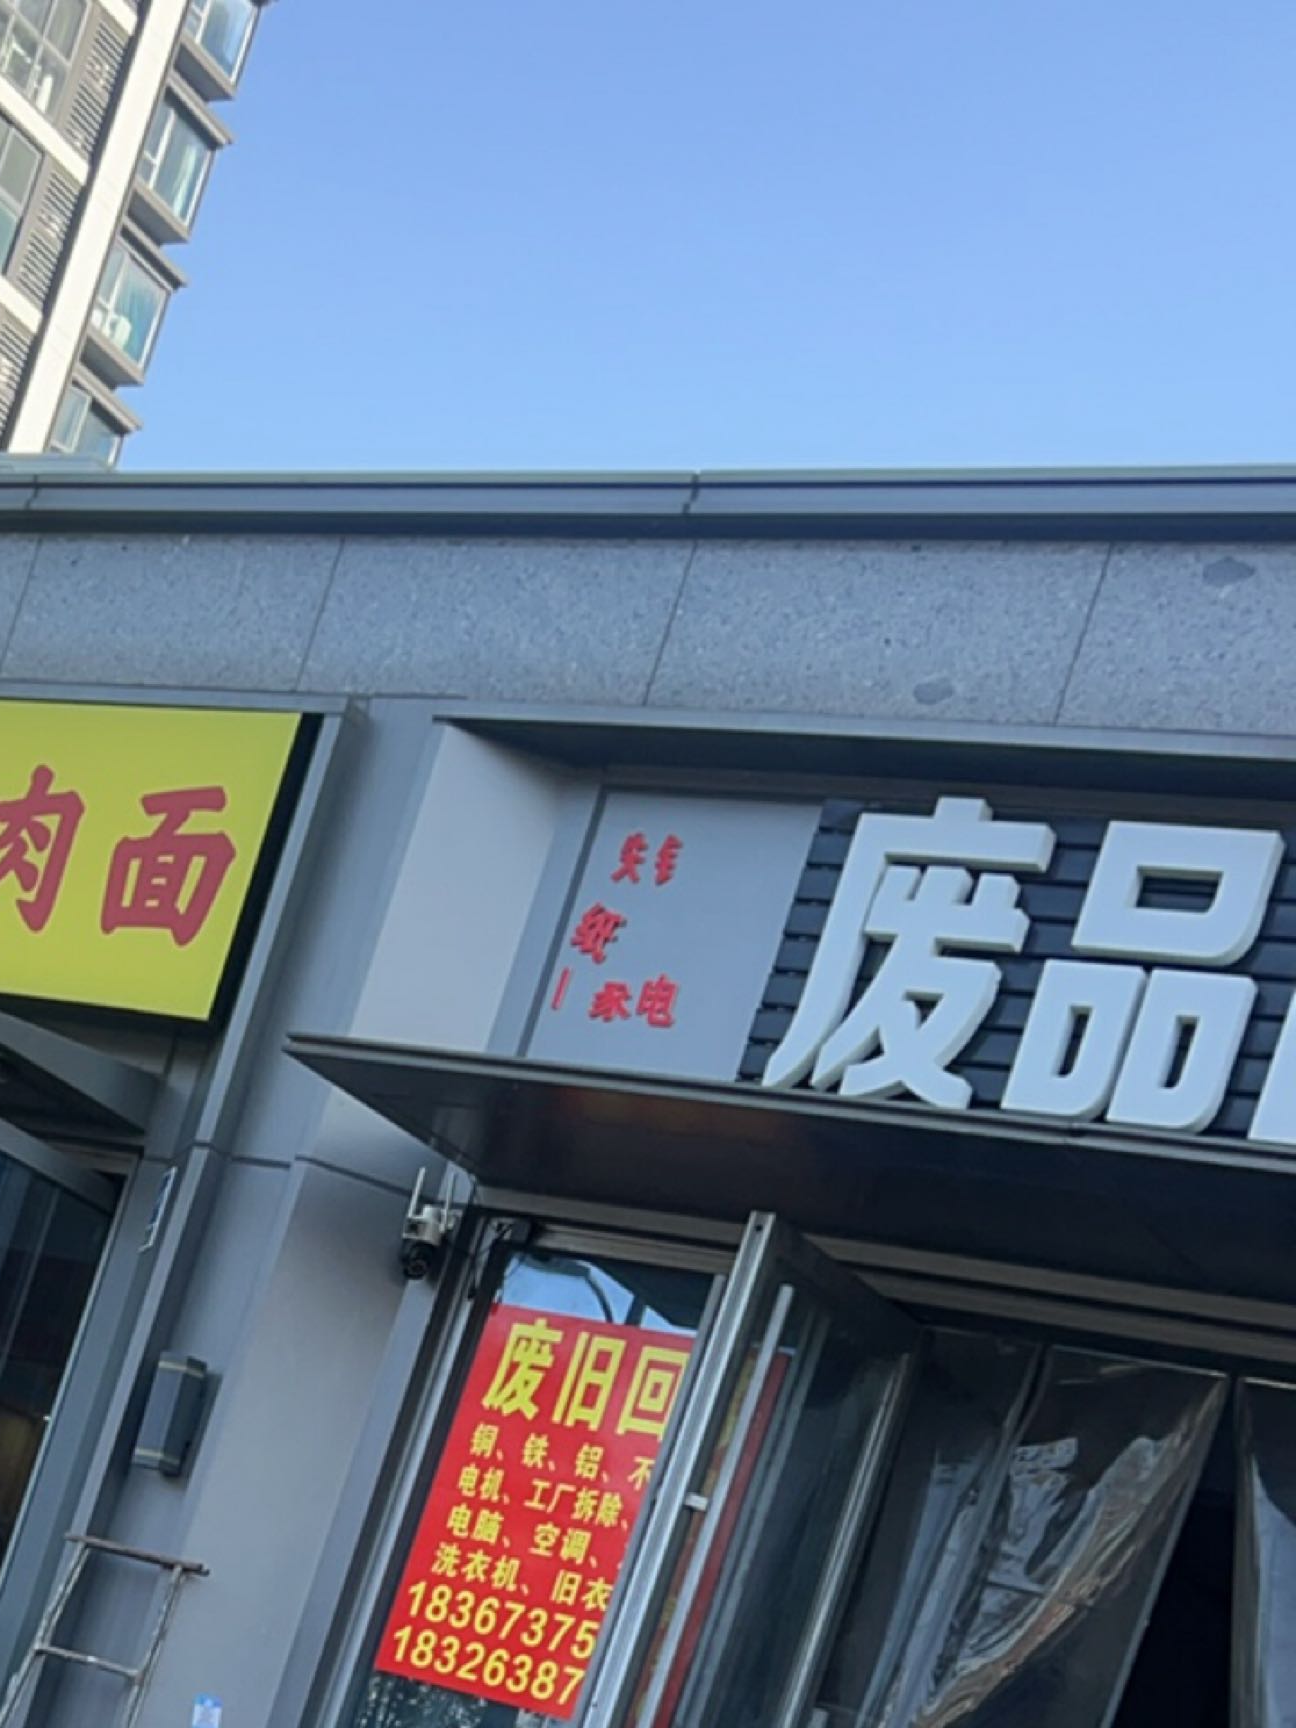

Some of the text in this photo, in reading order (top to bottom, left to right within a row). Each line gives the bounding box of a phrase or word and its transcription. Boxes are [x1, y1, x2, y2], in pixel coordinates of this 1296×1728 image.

[763, 796, 1296, 1142] 废品
[481, 1318, 690, 1441] 废旧回
[446, 1502, 630, 1570] 电脑、空调、
[408, 1580, 602, 1661] 18367375
[392, 1624, 586, 1706] 18326387
